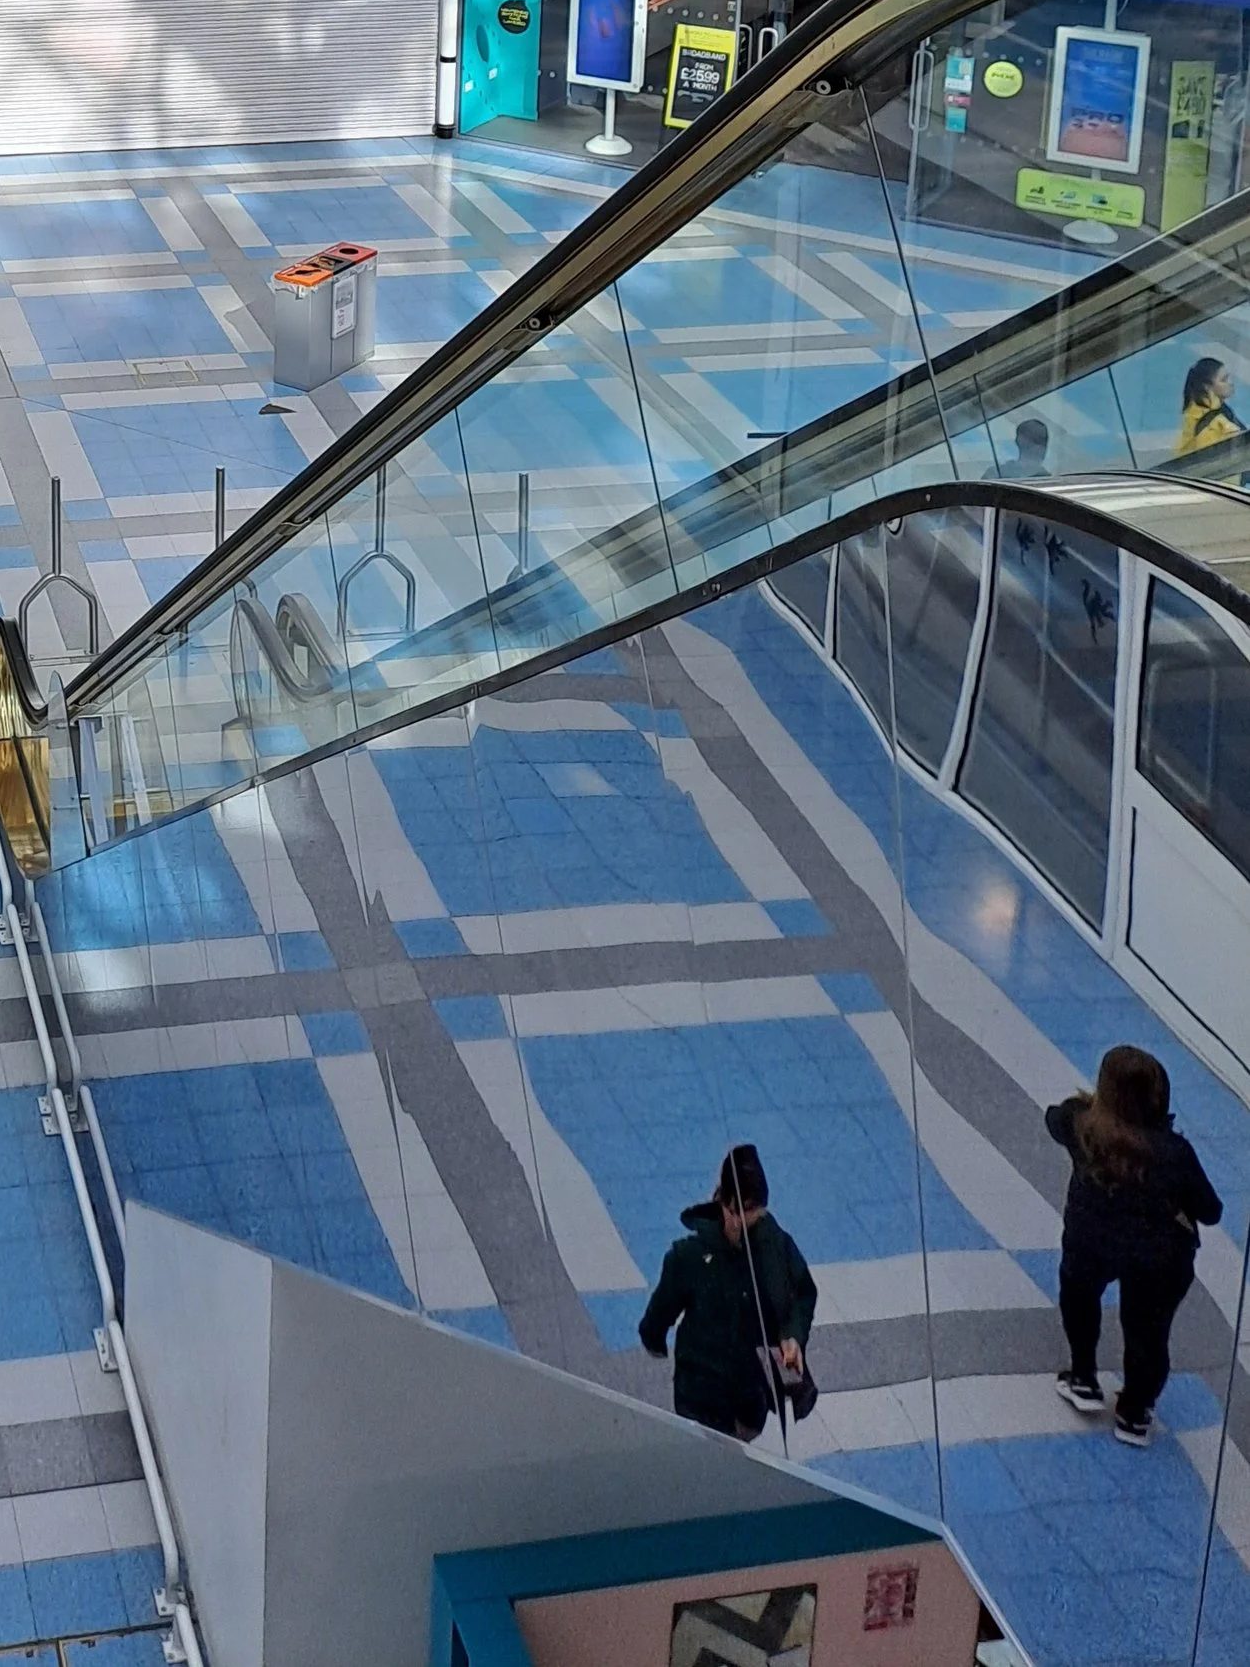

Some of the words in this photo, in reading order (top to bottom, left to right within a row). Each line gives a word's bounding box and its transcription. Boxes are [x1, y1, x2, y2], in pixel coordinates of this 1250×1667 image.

[682, 48, 726, 61] BROADBAND
[694, 62, 715, 71] FROM
[682, 80, 690, 88] A
[692, 82, 718, 92] MONTH
